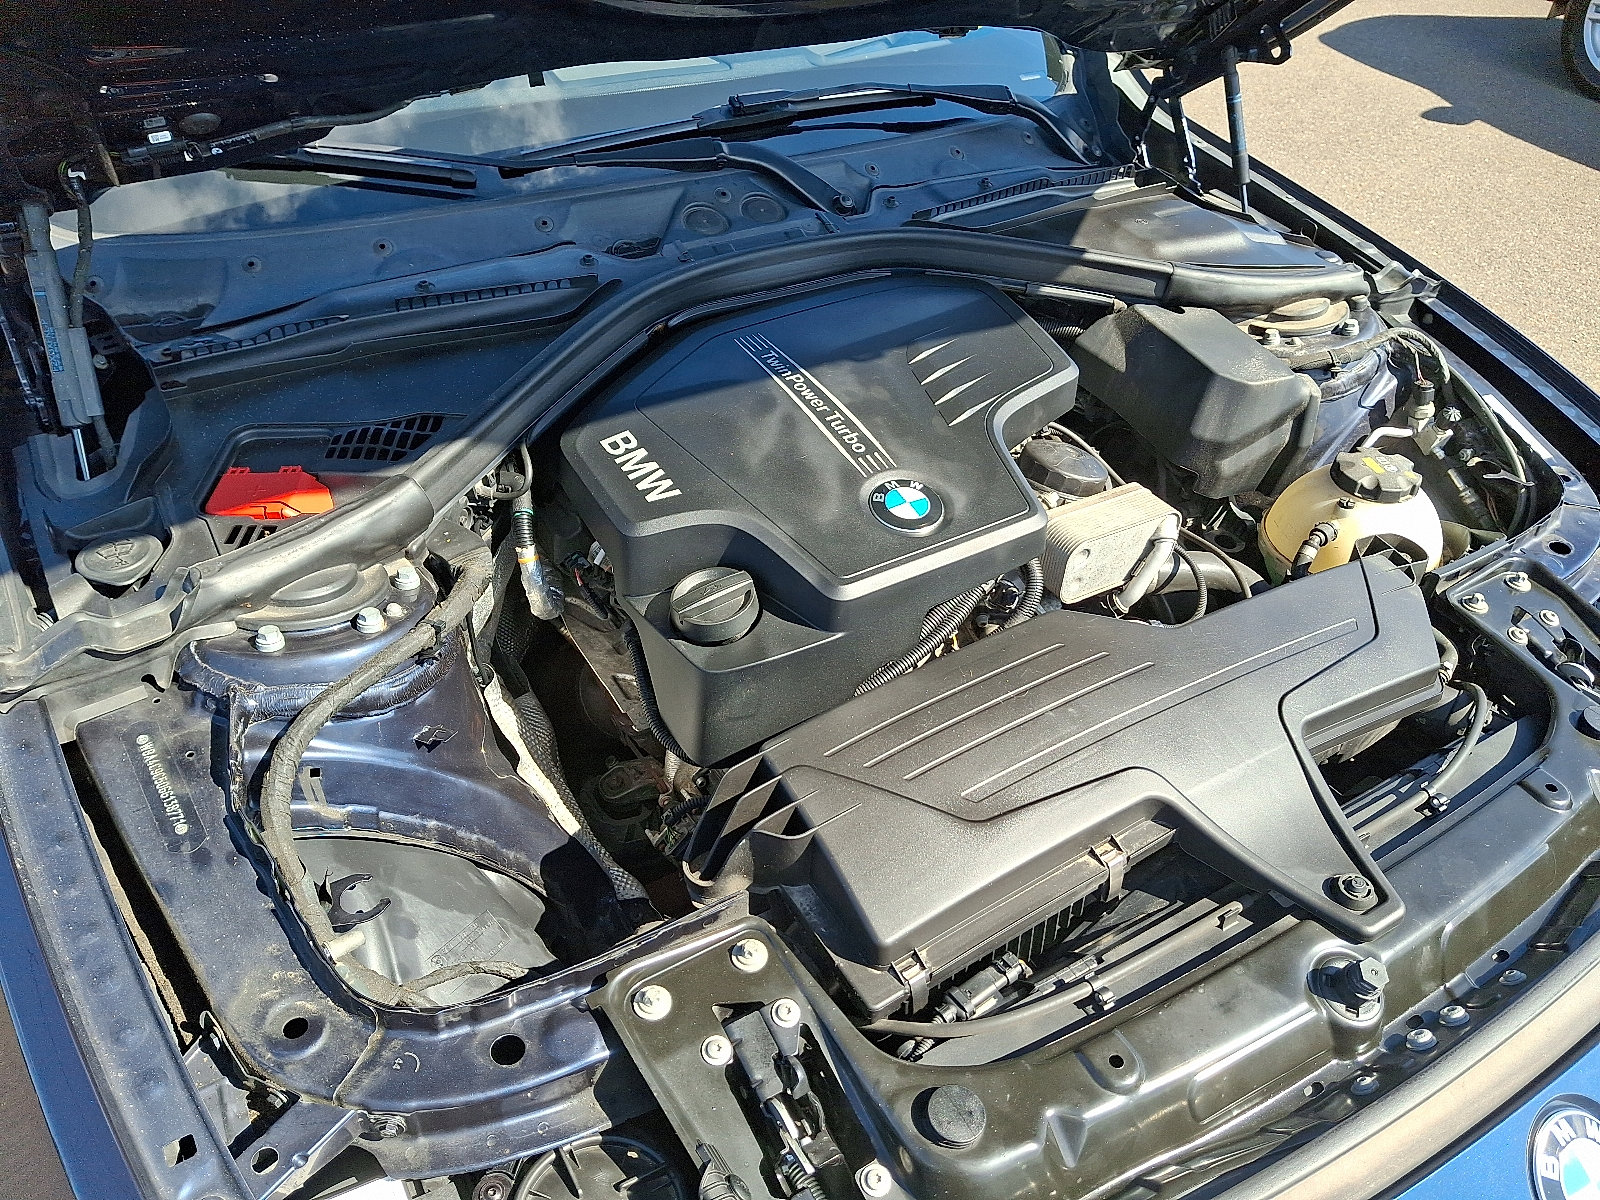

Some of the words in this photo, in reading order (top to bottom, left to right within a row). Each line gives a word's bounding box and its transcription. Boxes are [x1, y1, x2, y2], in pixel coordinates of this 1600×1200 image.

[761, 350, 830, 413] TwinPower
[825, 410, 866, 454] Turbo
[599, 429, 683, 503] BMW
[873, 480, 924, 503] BMW
[1540, 1116, 1600, 1182] BMW
